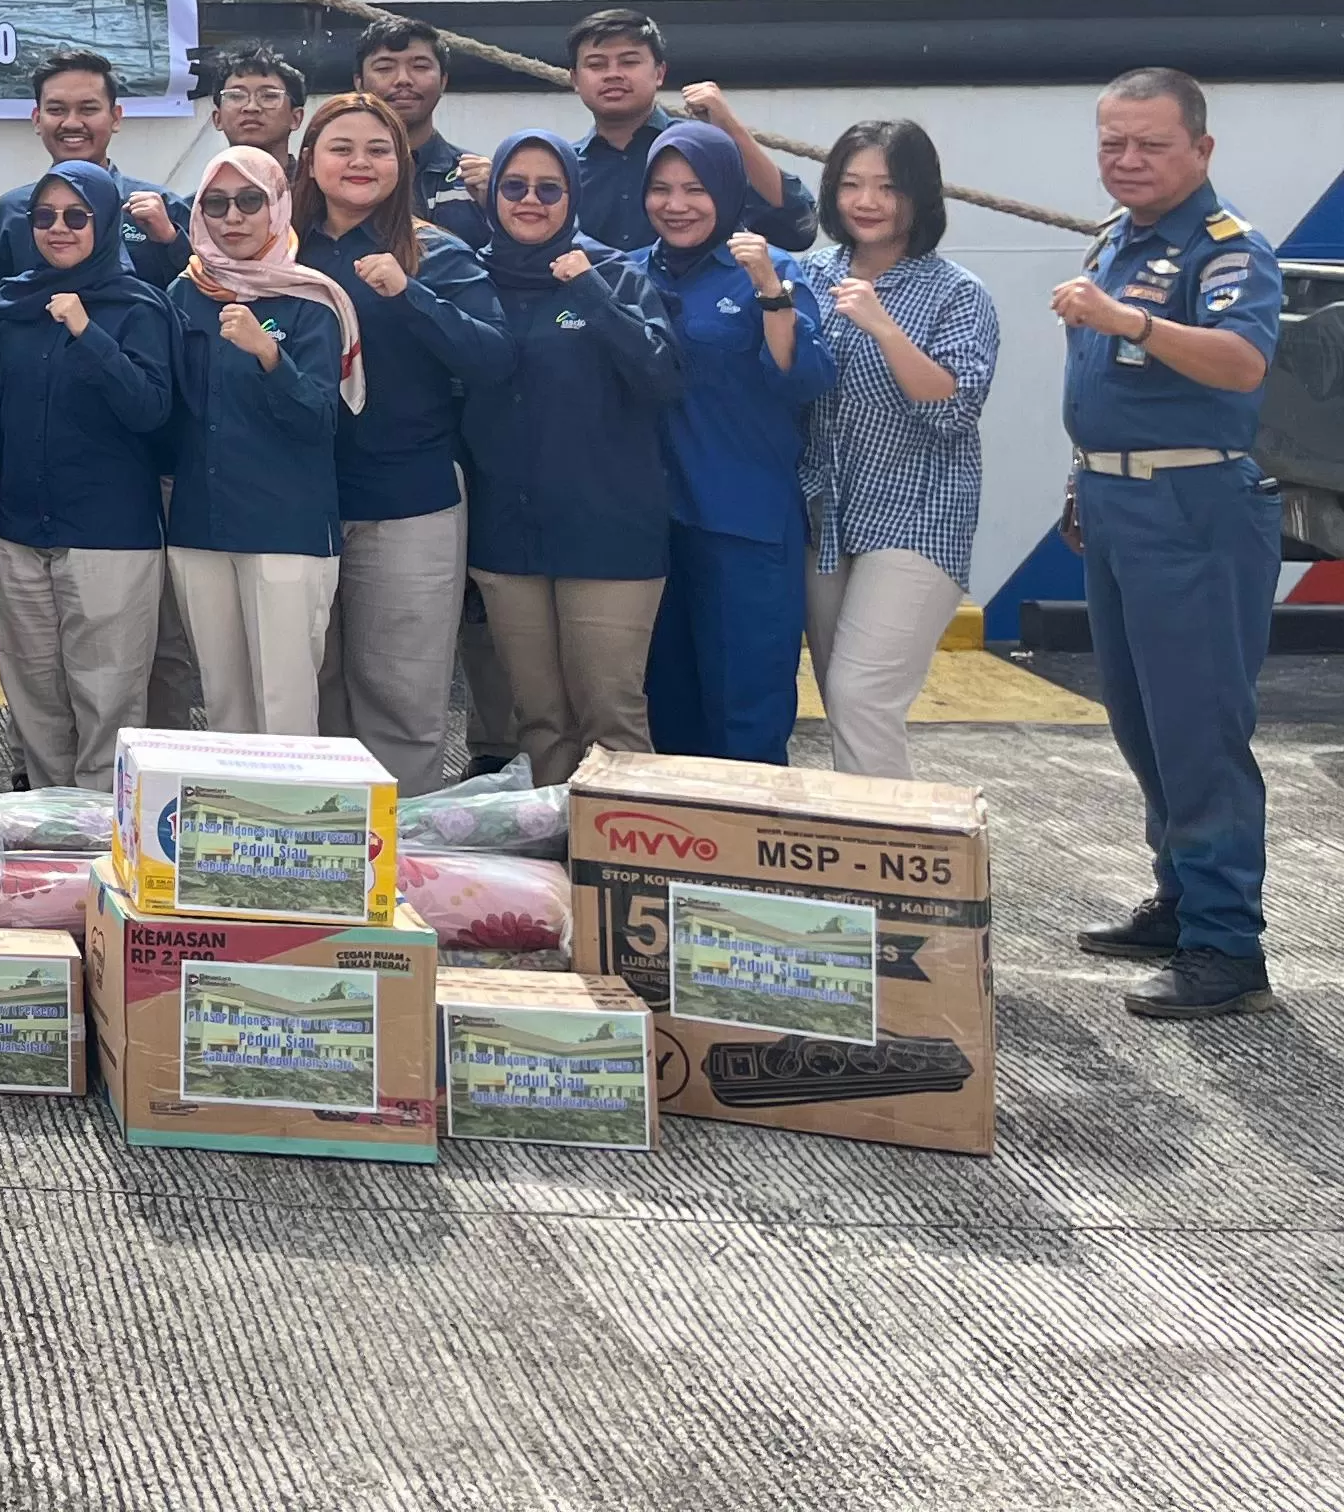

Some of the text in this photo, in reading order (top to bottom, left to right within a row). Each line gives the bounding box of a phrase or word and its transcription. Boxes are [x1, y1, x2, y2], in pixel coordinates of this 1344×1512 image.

[233, 841, 308, 860] Peduli Siau
[757, 840, 841, 872] MSP
[879, 852, 953, 886] N35
[601, 868, 641, 883] STOP
[900, 901, 952, 919] KABEL
[625, 895, 669, 957] 5
[130, 929, 226, 948] KEMASAN
[131, 949, 156, 965] RP
[336, 952, 404, 961] CEGAH RUAM
[337, 961, 409, 972] BEKAS MERAH
[239, 1031, 316, 1050] Peduli Siau
[506, 1072, 586, 1092] Peduli Siau
